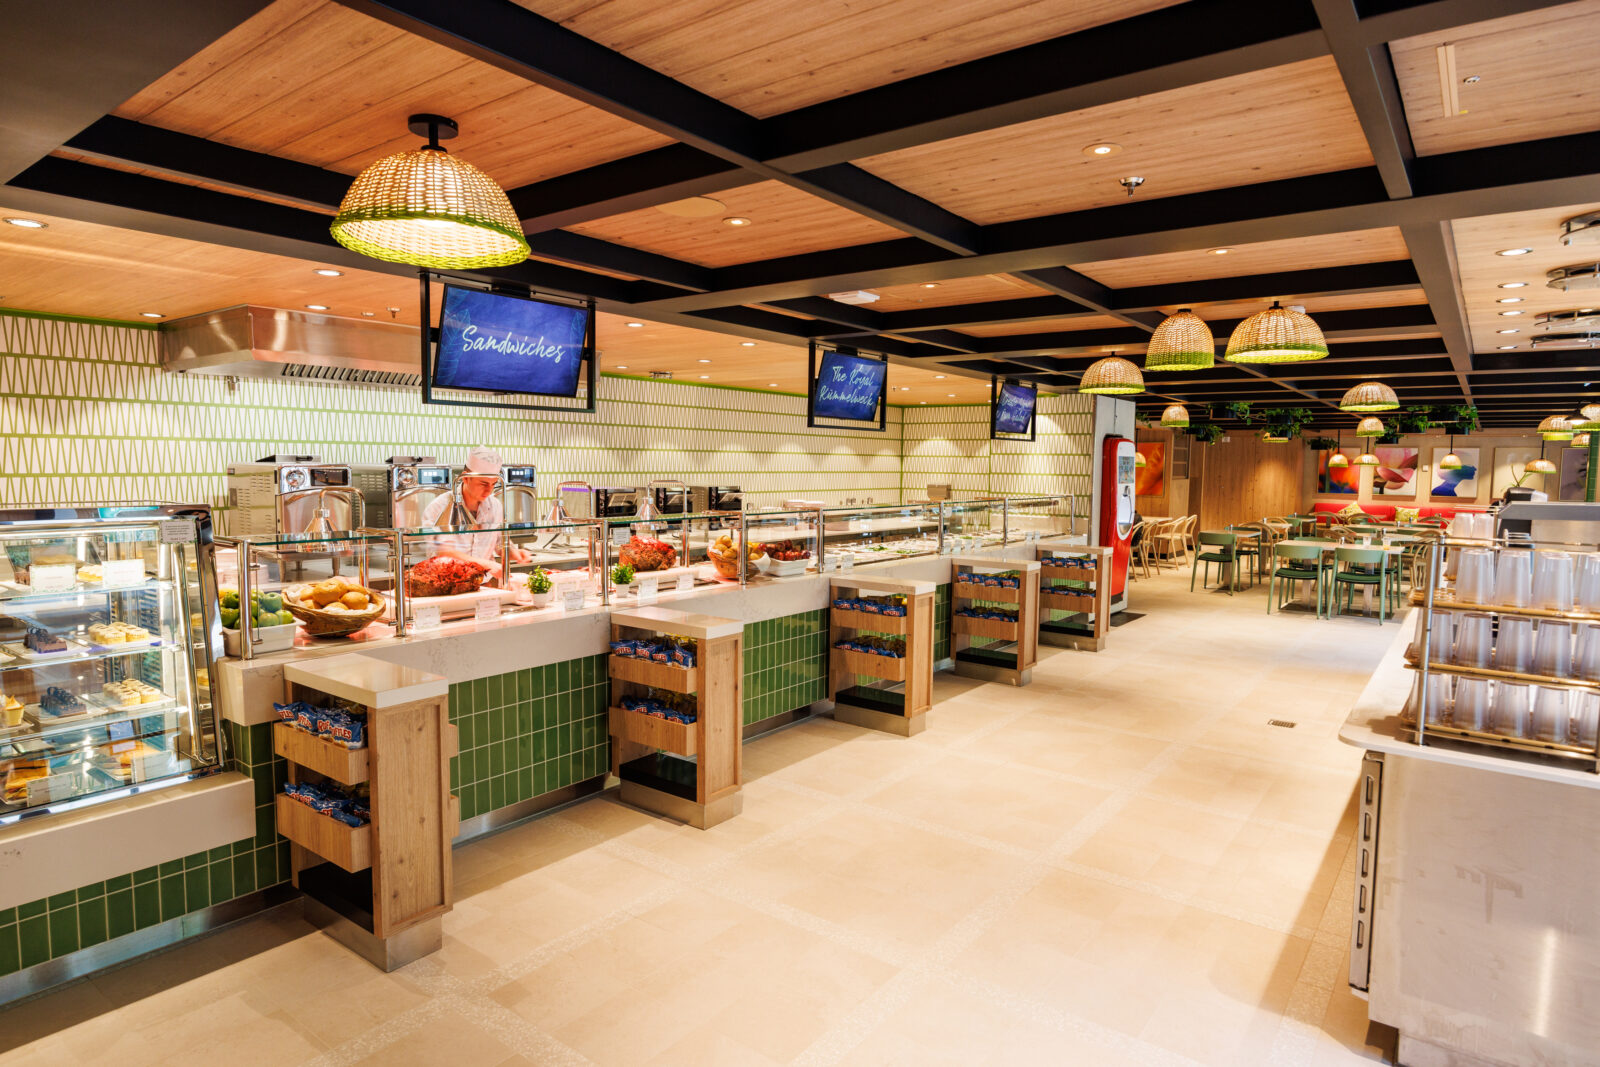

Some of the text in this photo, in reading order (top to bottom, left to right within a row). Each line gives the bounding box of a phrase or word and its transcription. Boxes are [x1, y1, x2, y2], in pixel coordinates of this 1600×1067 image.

[462, 325, 565, 363] Sandwiches
[832, 364, 875, 389] The Royal
